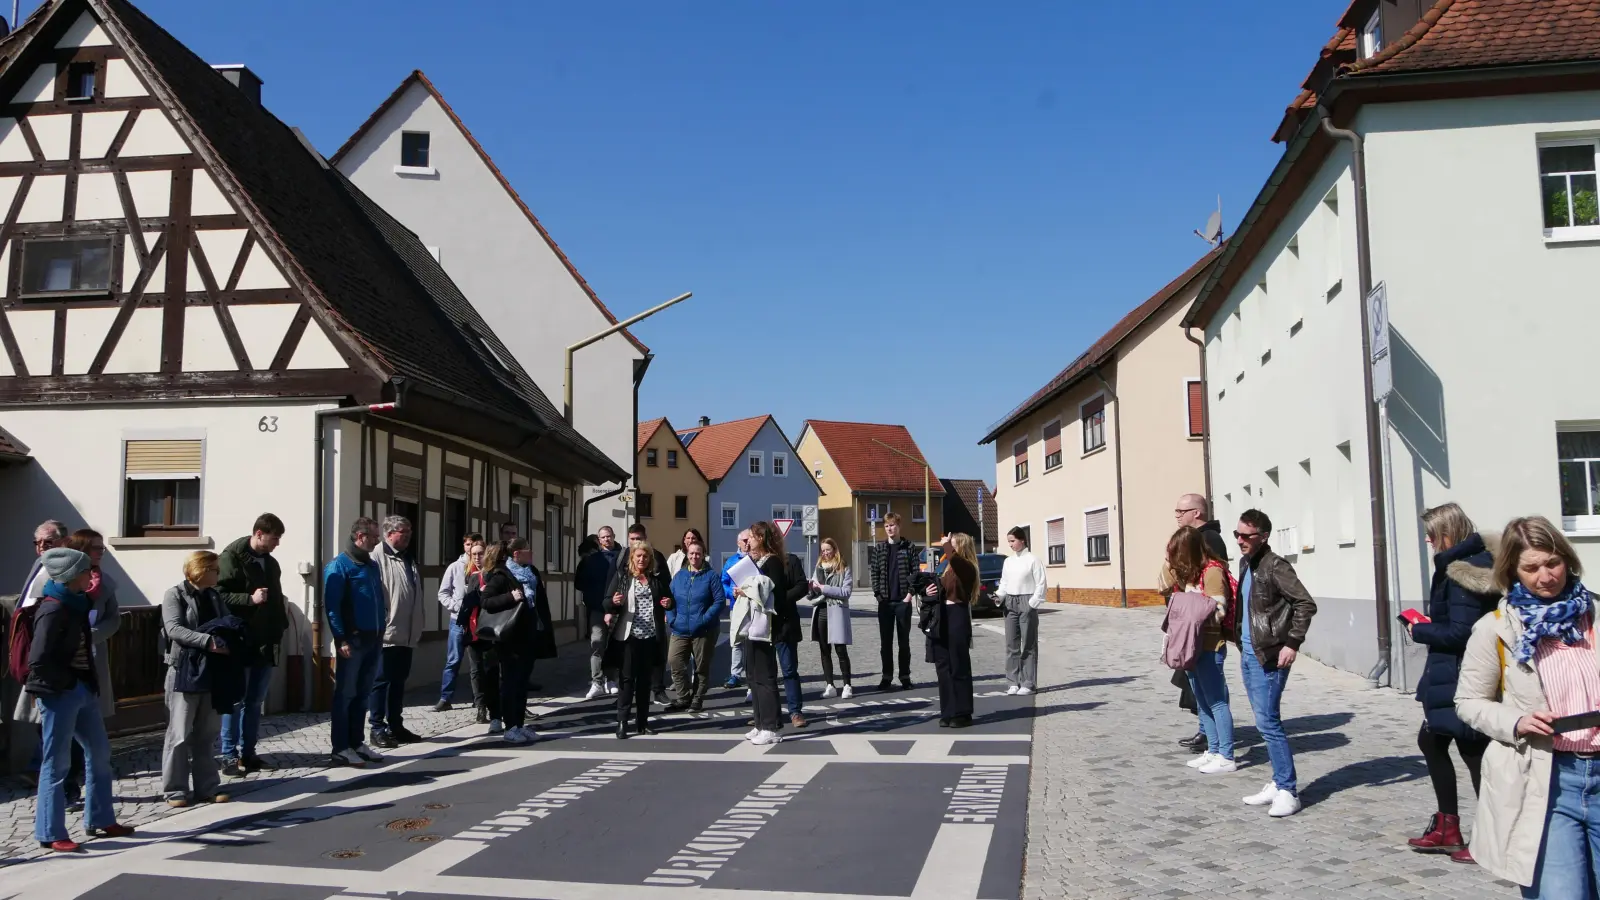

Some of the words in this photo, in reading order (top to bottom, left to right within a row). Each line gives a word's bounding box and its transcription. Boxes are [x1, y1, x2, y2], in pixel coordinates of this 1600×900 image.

[258, 415, 279, 433] 63
[940, 764, 1009, 824] ERWÄHNT
[639, 782, 807, 888] URKUNDLICH
